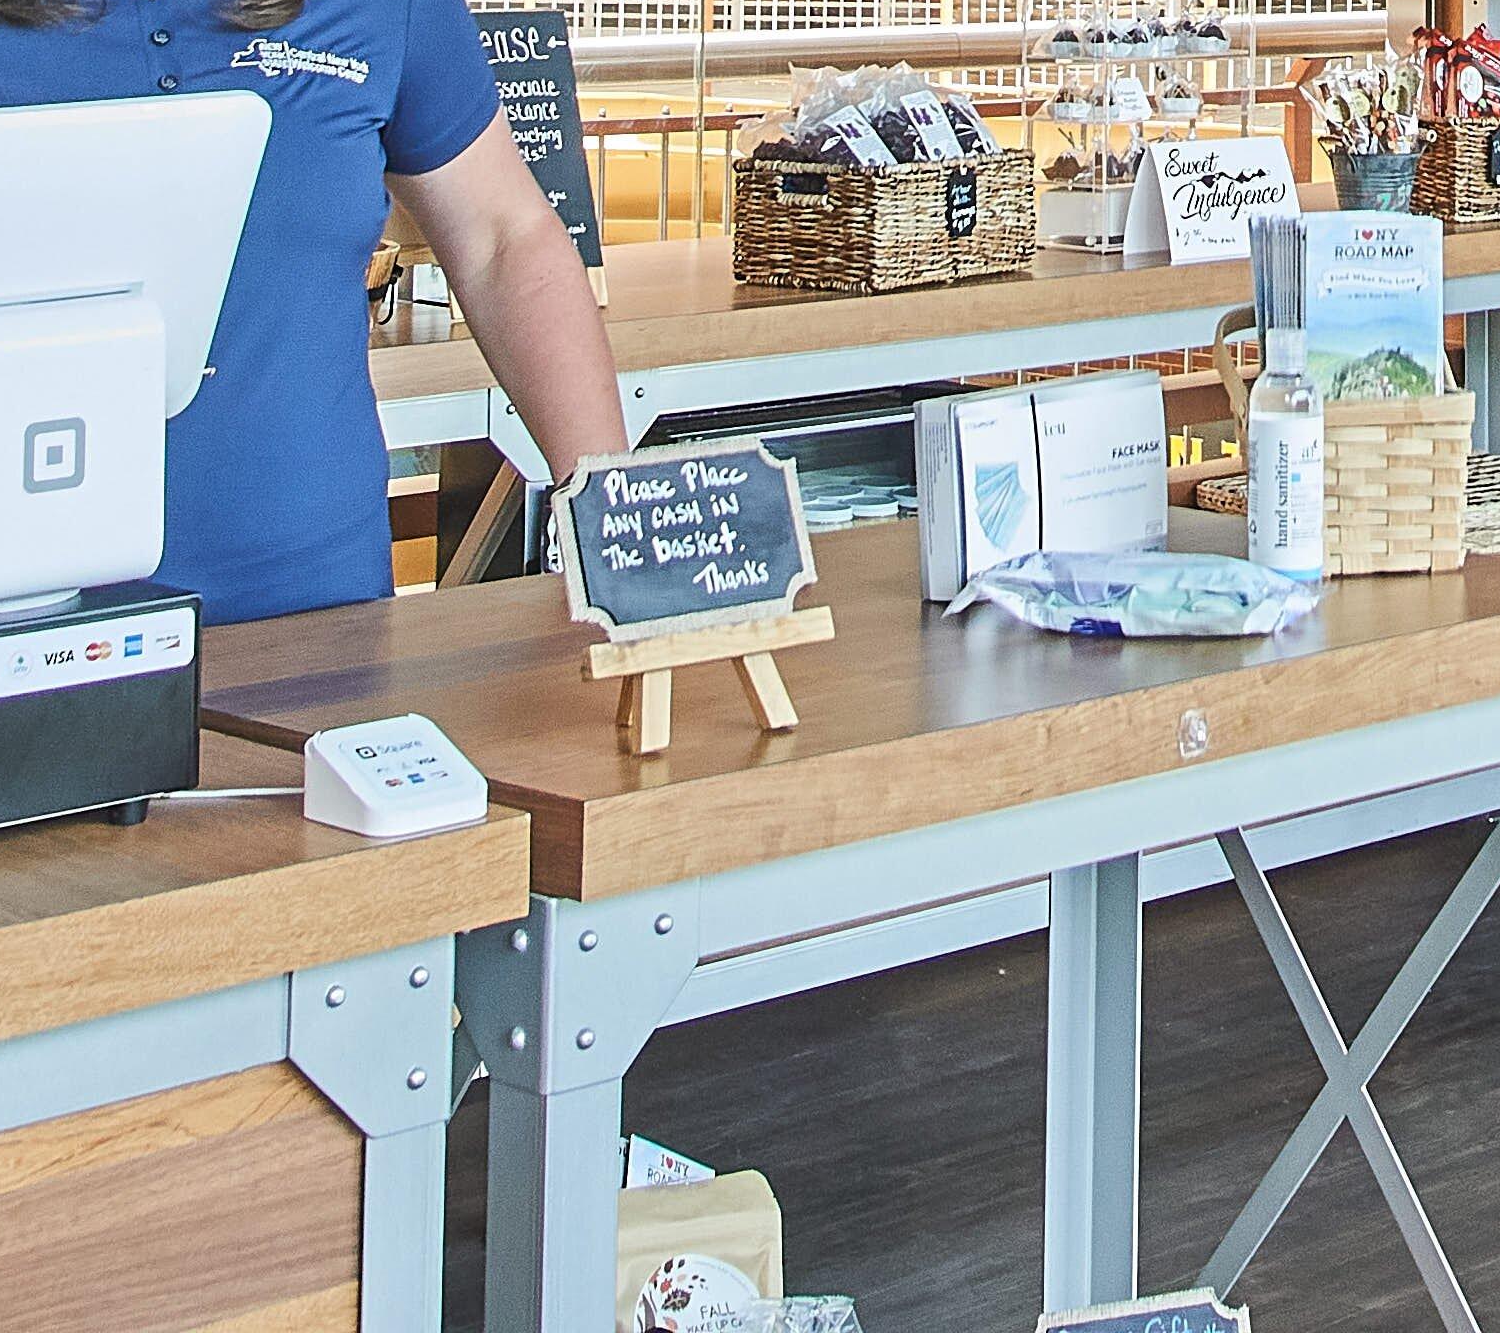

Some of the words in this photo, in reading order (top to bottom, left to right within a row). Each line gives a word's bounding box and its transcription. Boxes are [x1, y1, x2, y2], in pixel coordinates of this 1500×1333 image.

[1165, 148, 1220, 177] Sweet
[1173, 182, 1286, 222] Indulgence
[1354, 228, 1359, 241] I
[1376, 228, 1399, 241] NY
[1334, 245, 1376, 259] ROAD
[1381, 246, 1414, 259] MAP
[1111, 443, 1135, 459] FACE
[1136, 440, 1160, 457] MASK
[603, 469, 676, 506] Please
[681, 461, 748, 492] Place
[1274, 439, 1290, 505] sanitizer
[602, 511, 643, 541] ANY
[651, 503, 703, 529] CASH
[1274, 507, 1288, 549] hand
[602, 543, 643, 571] The
[692, 560, 770, 594] Thanks
[44, 650, 76, 666] VISA
[700, 1301, 736, 1319] FALL
